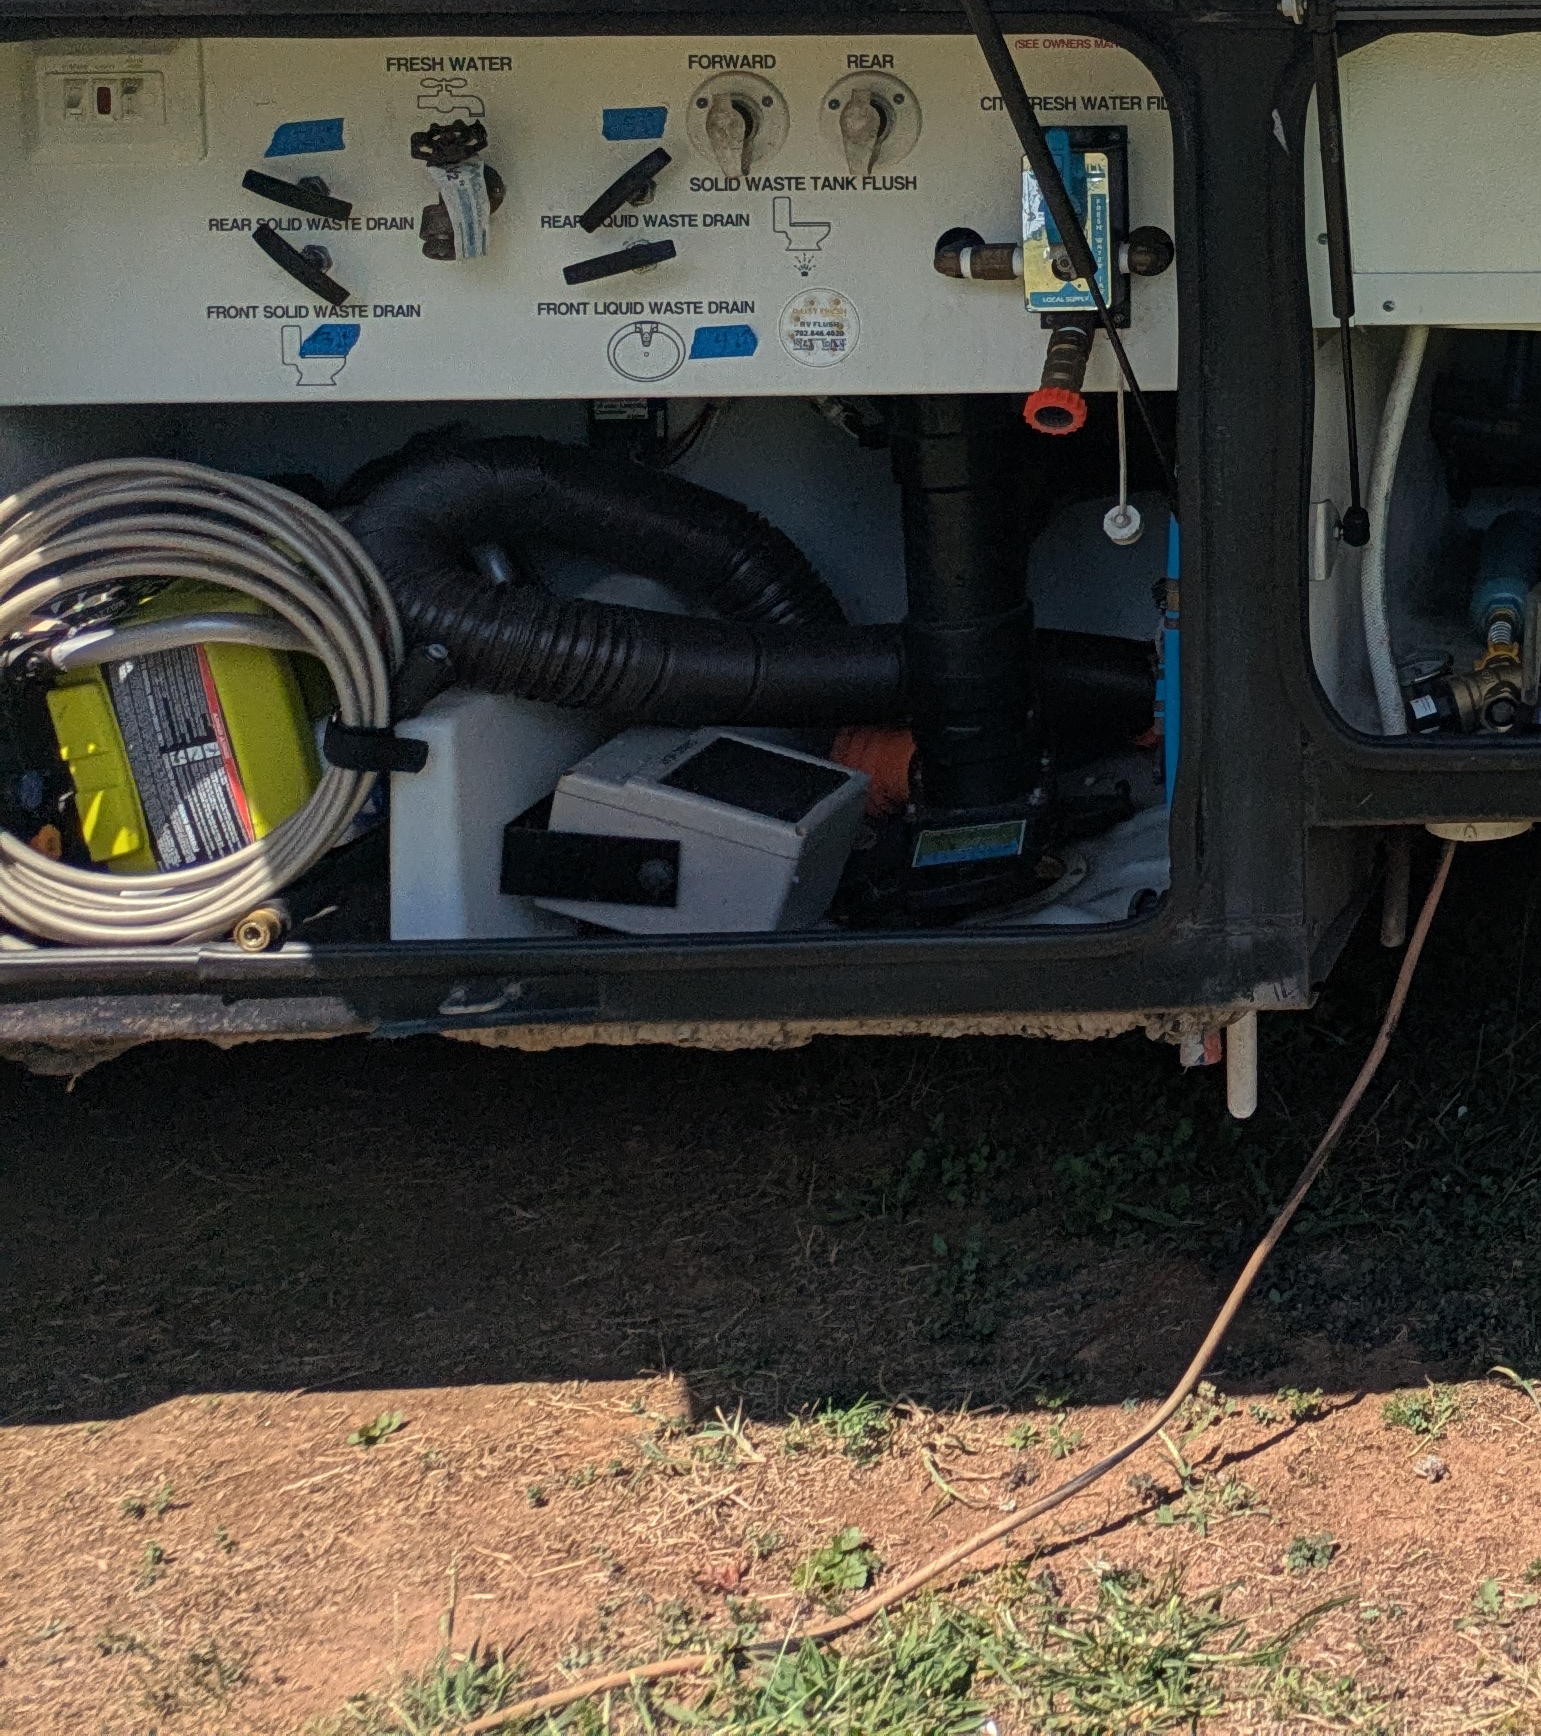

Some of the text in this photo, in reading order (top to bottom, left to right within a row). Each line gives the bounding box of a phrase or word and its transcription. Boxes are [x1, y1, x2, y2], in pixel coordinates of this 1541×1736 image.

[1014, 38, 1040, 50] (SEE
[1042, 38, 1092, 50] OWNERS
[385, 56, 513, 72] FRESH WATER
[688, 54, 777, 70] FORWARD
[846, 54, 894, 70] REAR
[980, 95, 1004, 111] CIT
[1030, 95, 1077, 111] RESH
[1080, 95, 1142, 111] WATER
[689, 175, 917, 193] SOLID WASTE TANK FLUSH
[602, 214, 639, 229] QUID
[643, 213, 699, 228] WASTE
[702, 213, 750, 227] DRAIN
[1095, 198, 1104, 231] FRESH
[208, 218, 252, 232] REAR
[306, 217, 362, 231] WASTE
[366, 216, 415, 231] DRAIN
[1095, 237, 1104, 269] WATER
[1041, 295, 1089, 303] LOCAL SUPPLY
[206, 304, 422, 320] FRONT SOLID WASTE DRAIN
[537, 300, 755, 316] FRONT LIQUID WASTE DRAIN
